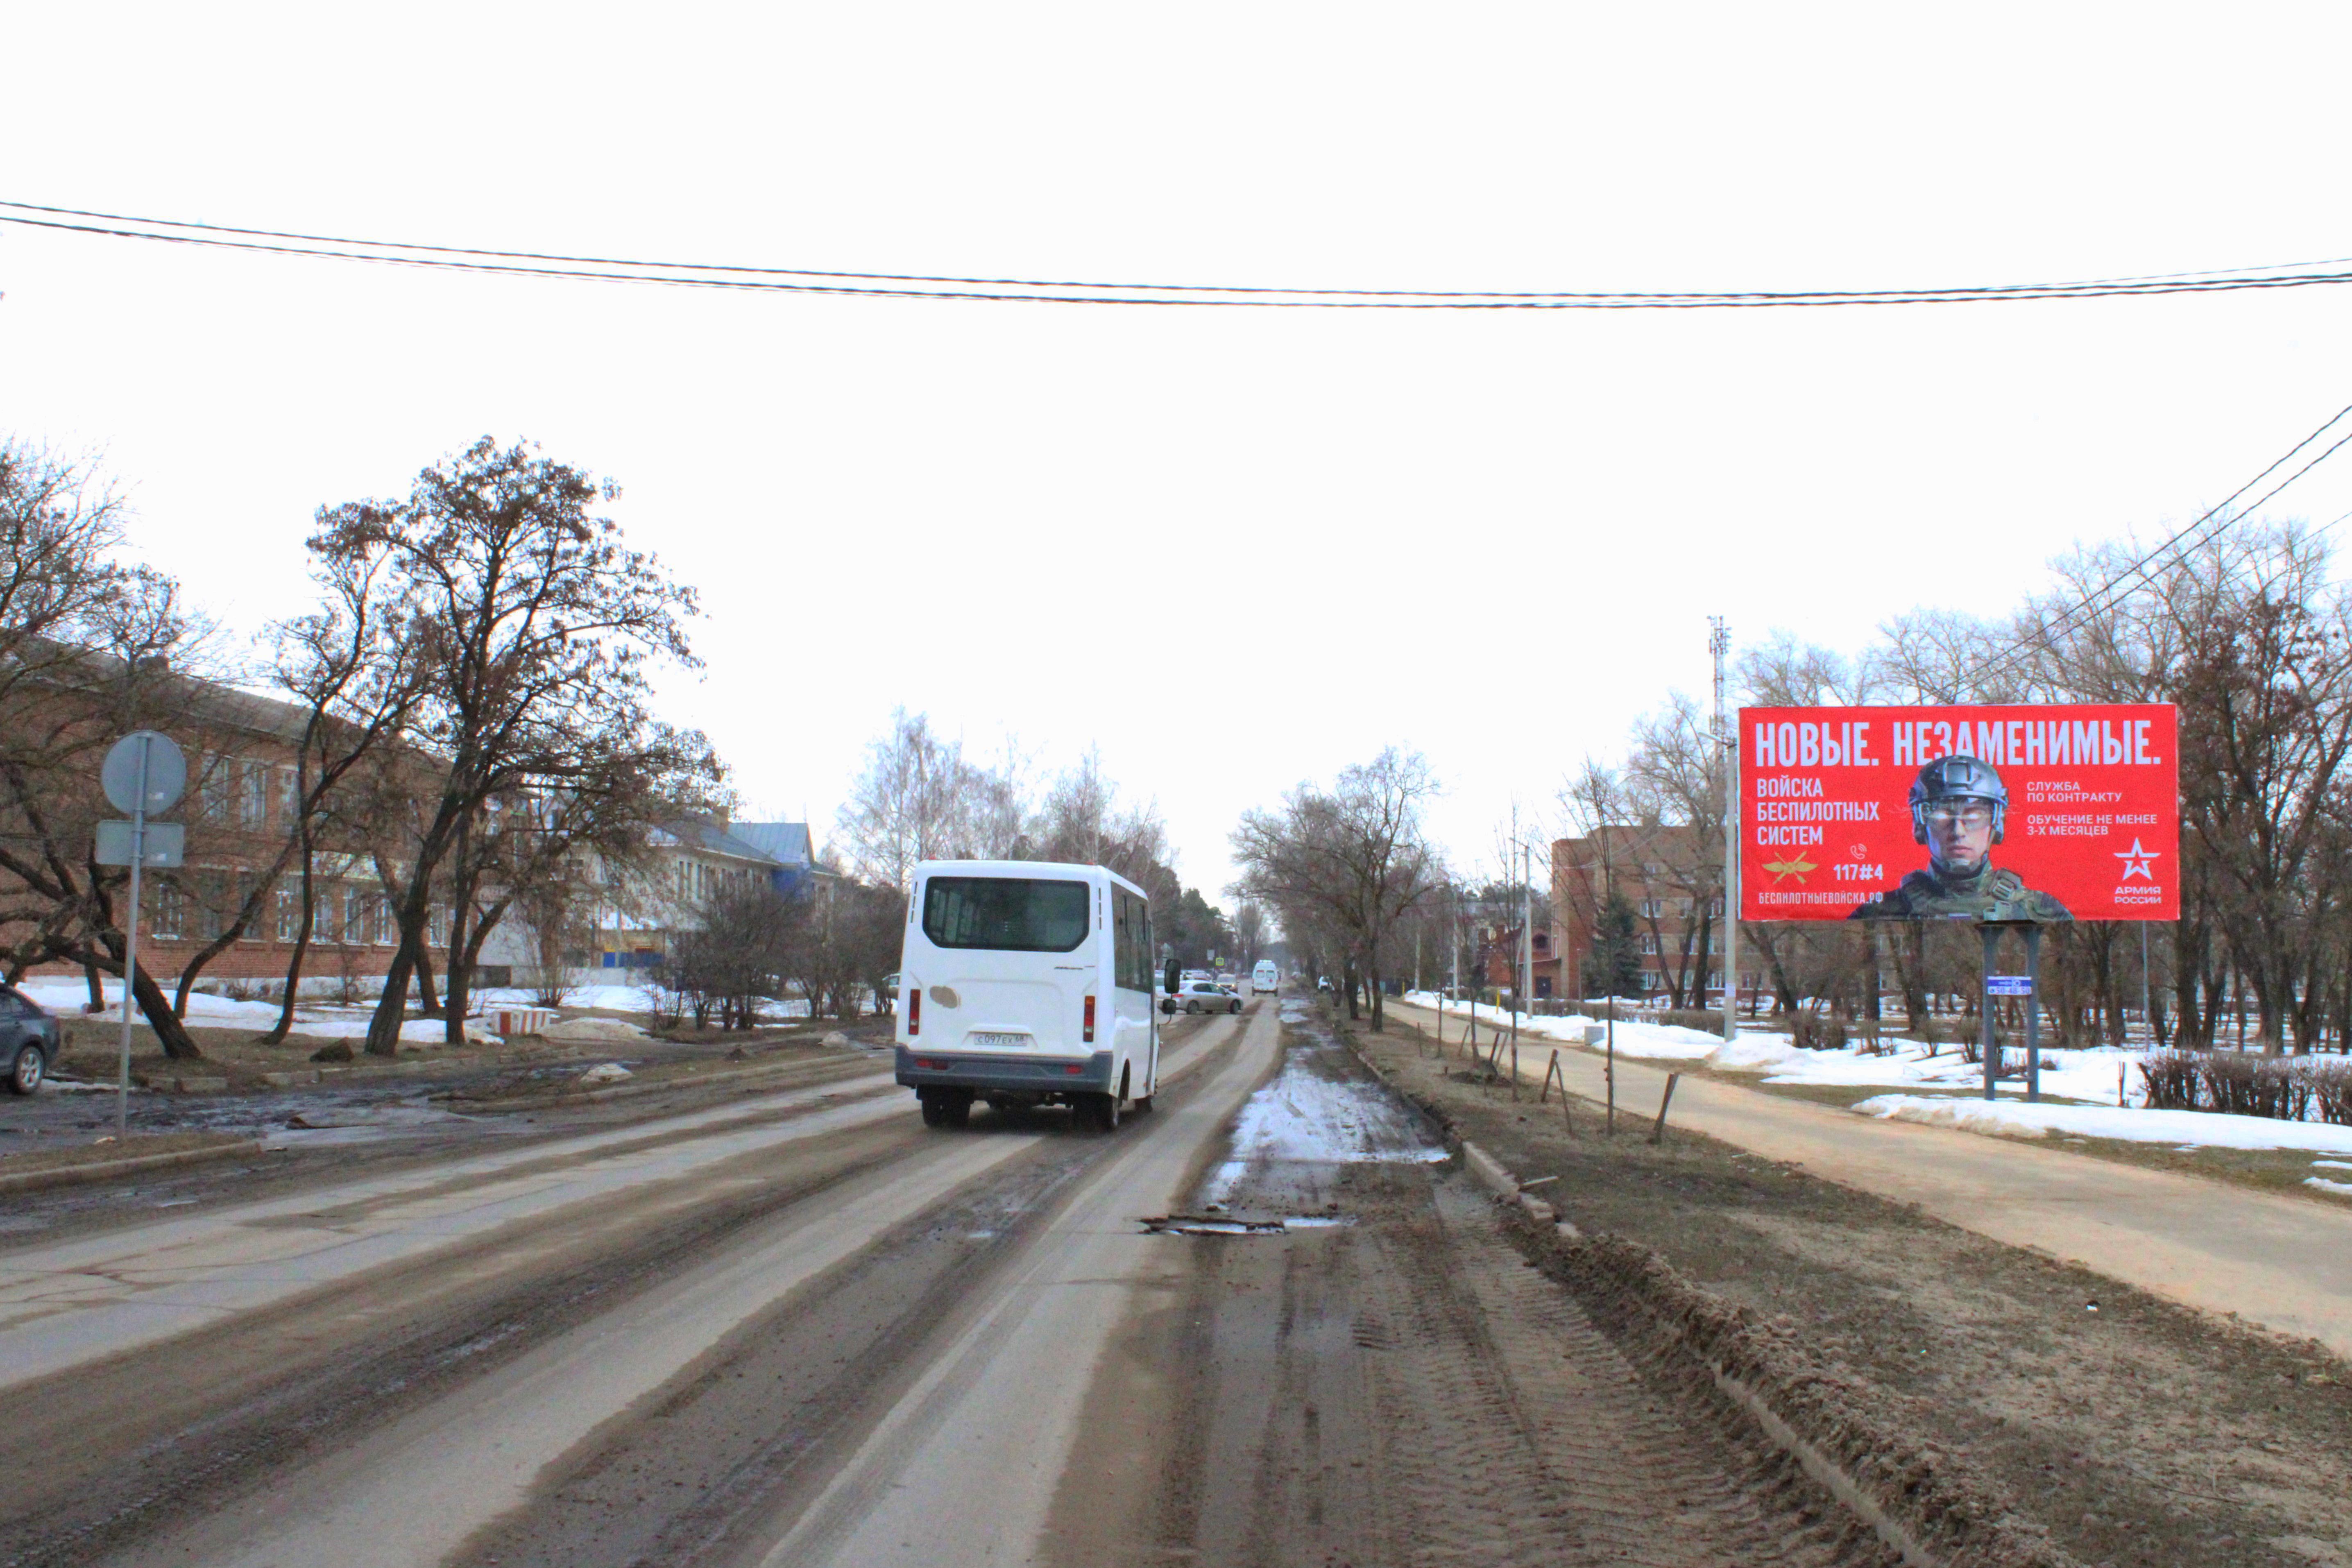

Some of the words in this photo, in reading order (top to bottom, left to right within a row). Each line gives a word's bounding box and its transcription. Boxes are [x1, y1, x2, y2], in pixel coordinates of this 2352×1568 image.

[1756, 722, 1879, 767] НОВЫЕ.
[1893, 721, 2161, 766] НЕЗАМЕНИМЫЕ.
[1757, 774, 1823, 797] ВОЙСКА
[2027, 782, 2080, 791] СЛУЖБА
[2027, 793, 2044, 802] ПО
[2048, 793, 2122, 802] КОНТРАКТУ
[1757, 802, 1880, 821] БЕСПИЛОТНЫХ
[2027, 814, 2093, 824] ОБУЧЕНИЕ
[2096, 814, 2112, 824] НЕ
[2115, 814, 2157, 824] МЕНЕЕ
[1757, 826, 1823, 845] СИСТЕМ
[2049, 826, 2108, 836] МЕСЯЦЕВ
[1833, 863, 1883, 880] 117#4
[2115, 886, 2162, 895] АРМИЯ
[1759, 890, 1884, 904] БЕСПИЛОТНЫЕВОЙСКА.РФ
[2114, 896, 2162, 904] РОССИИ
